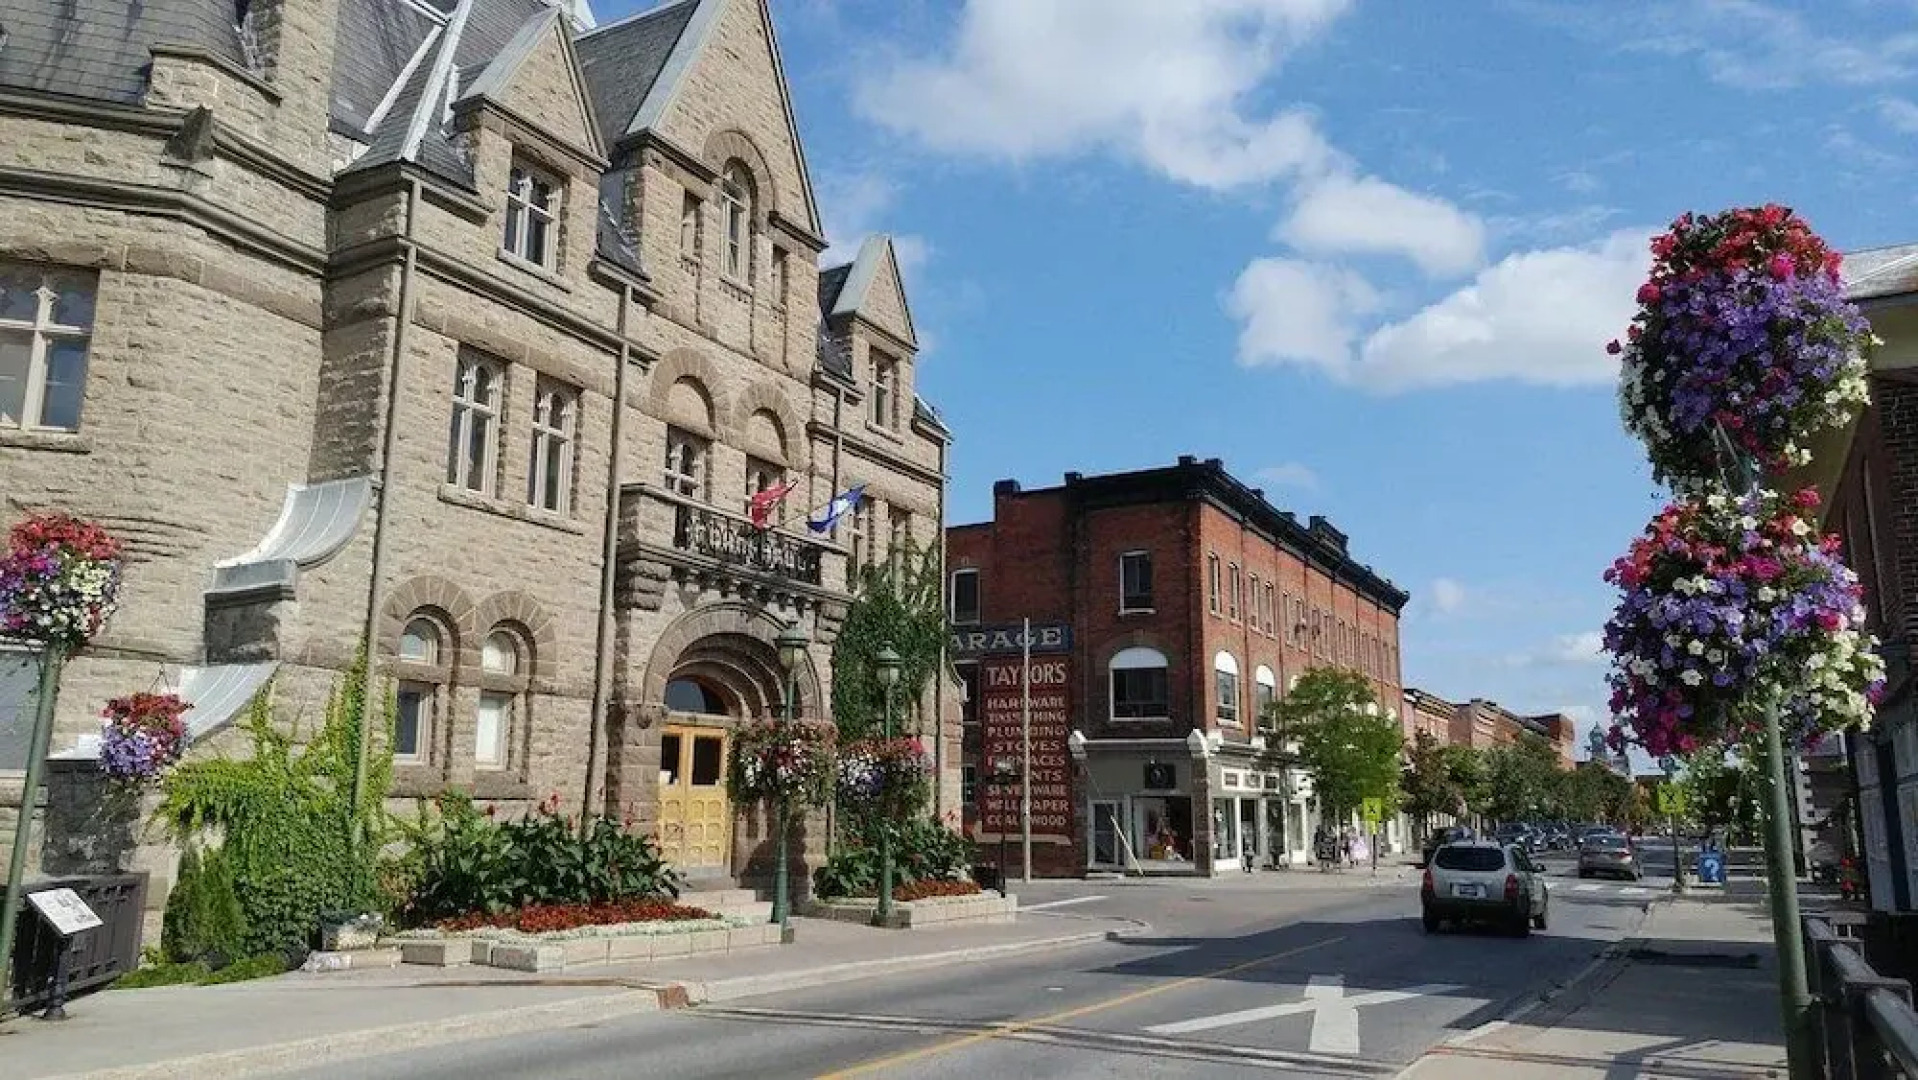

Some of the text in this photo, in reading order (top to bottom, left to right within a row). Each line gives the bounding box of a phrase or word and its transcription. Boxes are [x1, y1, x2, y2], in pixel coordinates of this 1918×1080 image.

[986, 662, 1067, 686] TAYOR'S
[987, 755, 1066, 767] FRNACES
[987, 784, 1067, 796] SIVEWARE
